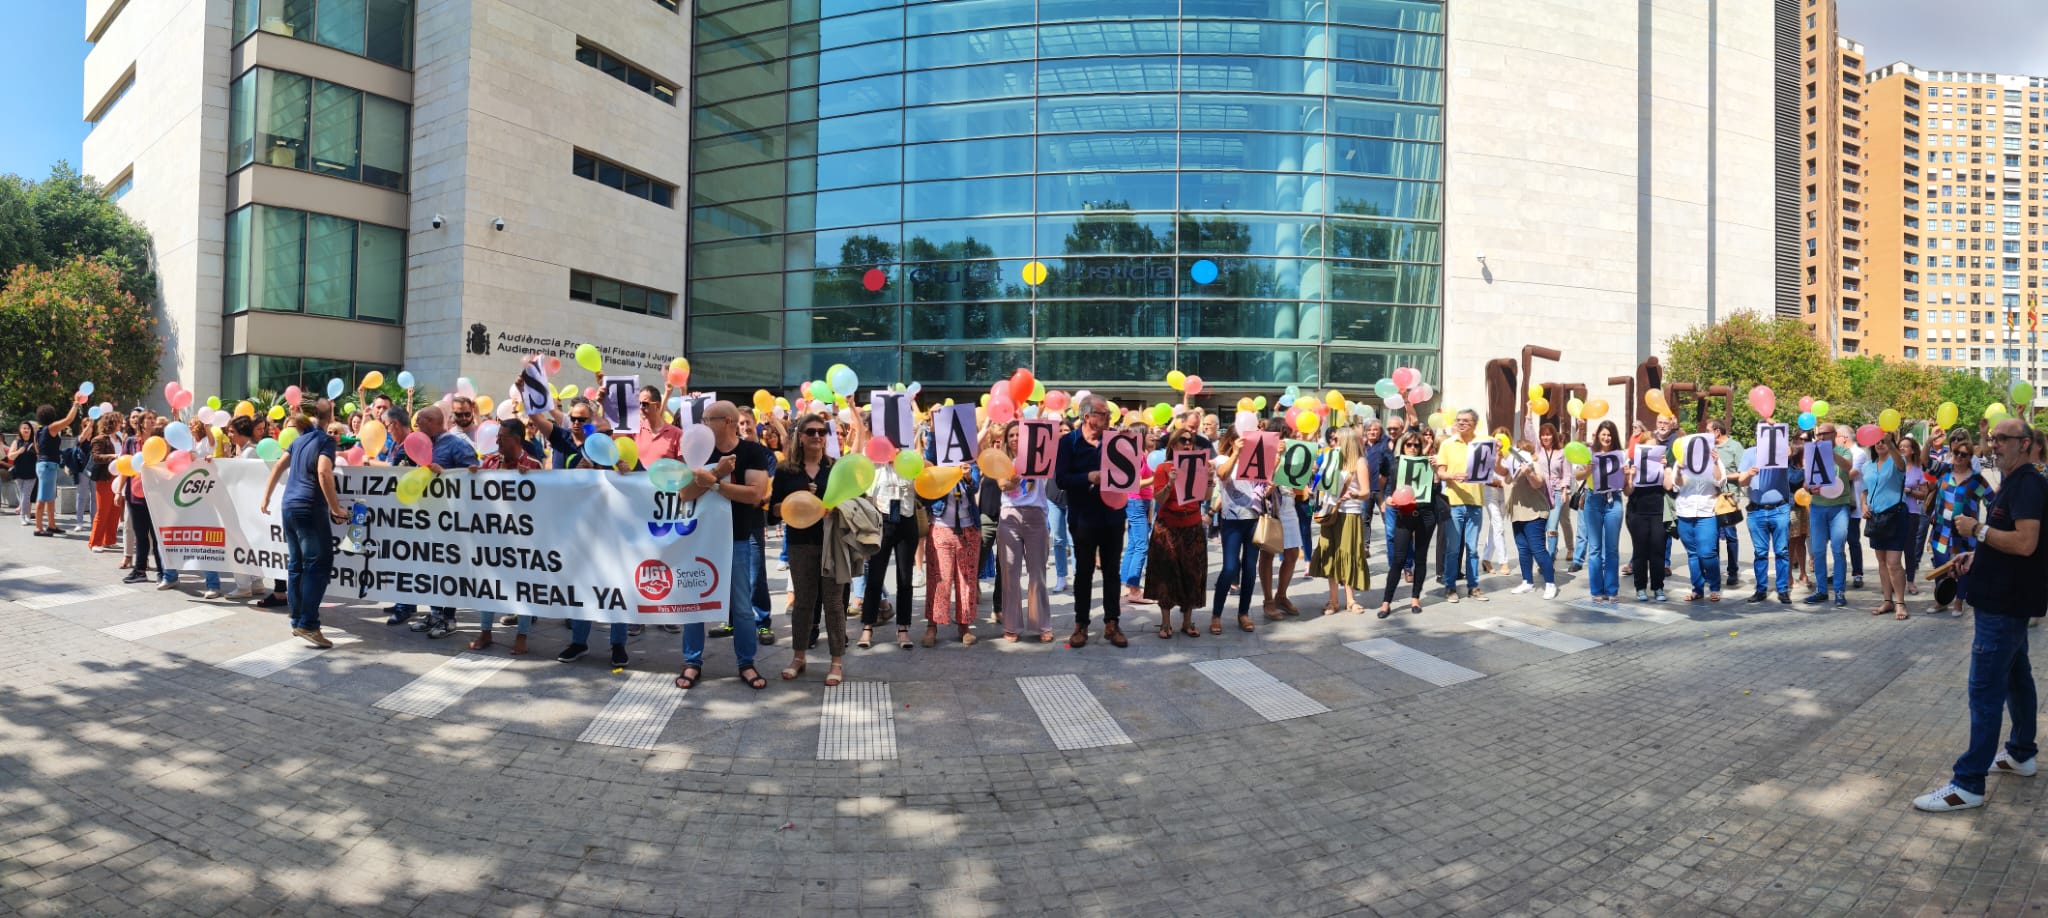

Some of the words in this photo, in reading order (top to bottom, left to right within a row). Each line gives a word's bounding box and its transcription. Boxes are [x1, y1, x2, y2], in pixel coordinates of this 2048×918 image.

[652, 353, 676, 364] Jutjat
[521, 360, 548, 410] S
[605, 379, 635, 431] T
[875, 394, 910, 448] I
[941, 408, 974, 463] A
[1021, 422, 1053, 477] E
[1106, 433, 1139, 489] S
[1239, 438, 1269, 480] A
[1282, 443, 1312, 487] Q
[1470, 442, 1495, 481] E
[1635, 446, 1661, 486] L
[1686, 434, 1710, 475] O
[1759, 426, 1786, 467] T
[1808, 445, 1834, 486] A
[471, 479, 537, 501] LOEO
[1178, 453, 1207, 501] T
[1406, 457, 1431, 500] E
[1596, 453, 1619, 492] P
[438, 511, 535, 536] CLARAS
[653, 490, 698, 520] STAJ
[162, 530, 203, 542] CCOO
[472, 547, 563, 573] JUSTAS
[639, 565, 668, 583] UGT
[676, 568, 706, 578] Serveis
[516, 581, 584, 608] REAL
[592, 586, 627, 611] YA
